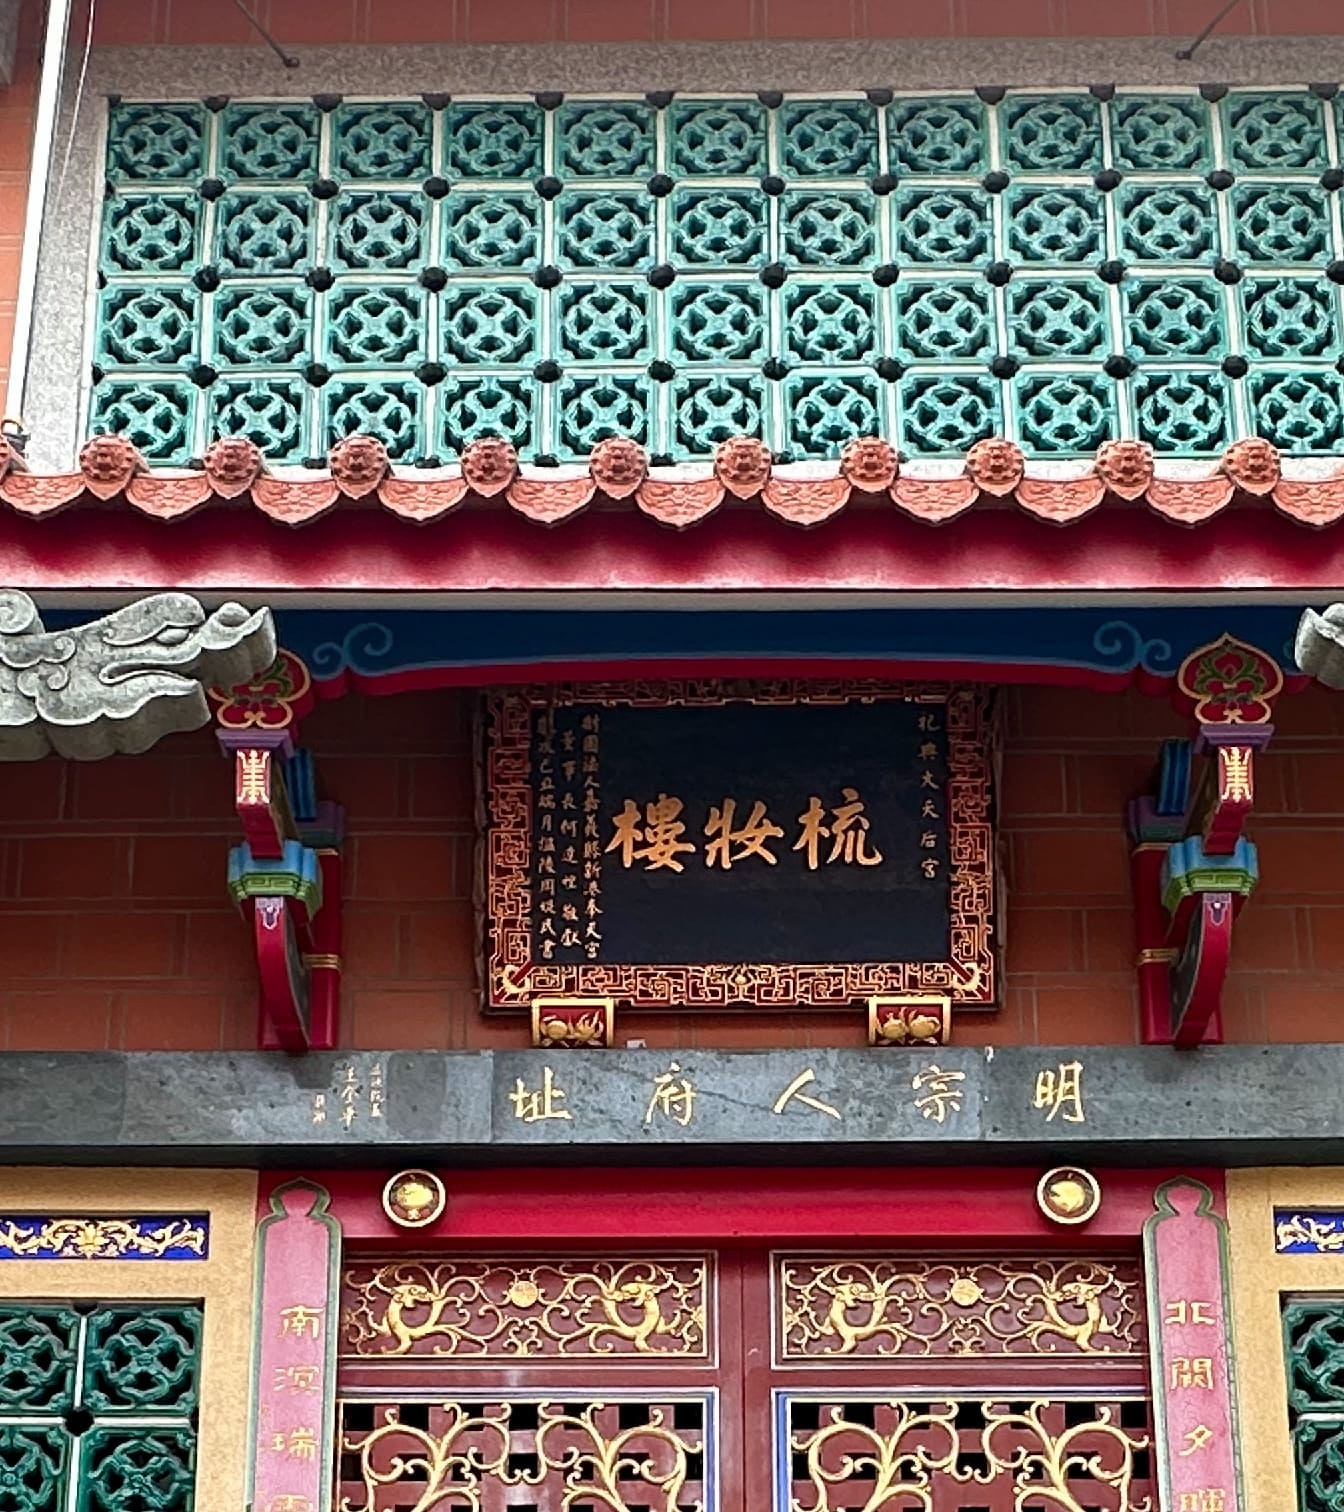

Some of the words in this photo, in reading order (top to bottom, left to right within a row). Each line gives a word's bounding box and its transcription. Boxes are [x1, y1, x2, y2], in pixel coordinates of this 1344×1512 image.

[604, 787, 884, 873] 梳妝樓
[507, 1061, 1088, 1127] 明宗人府址
